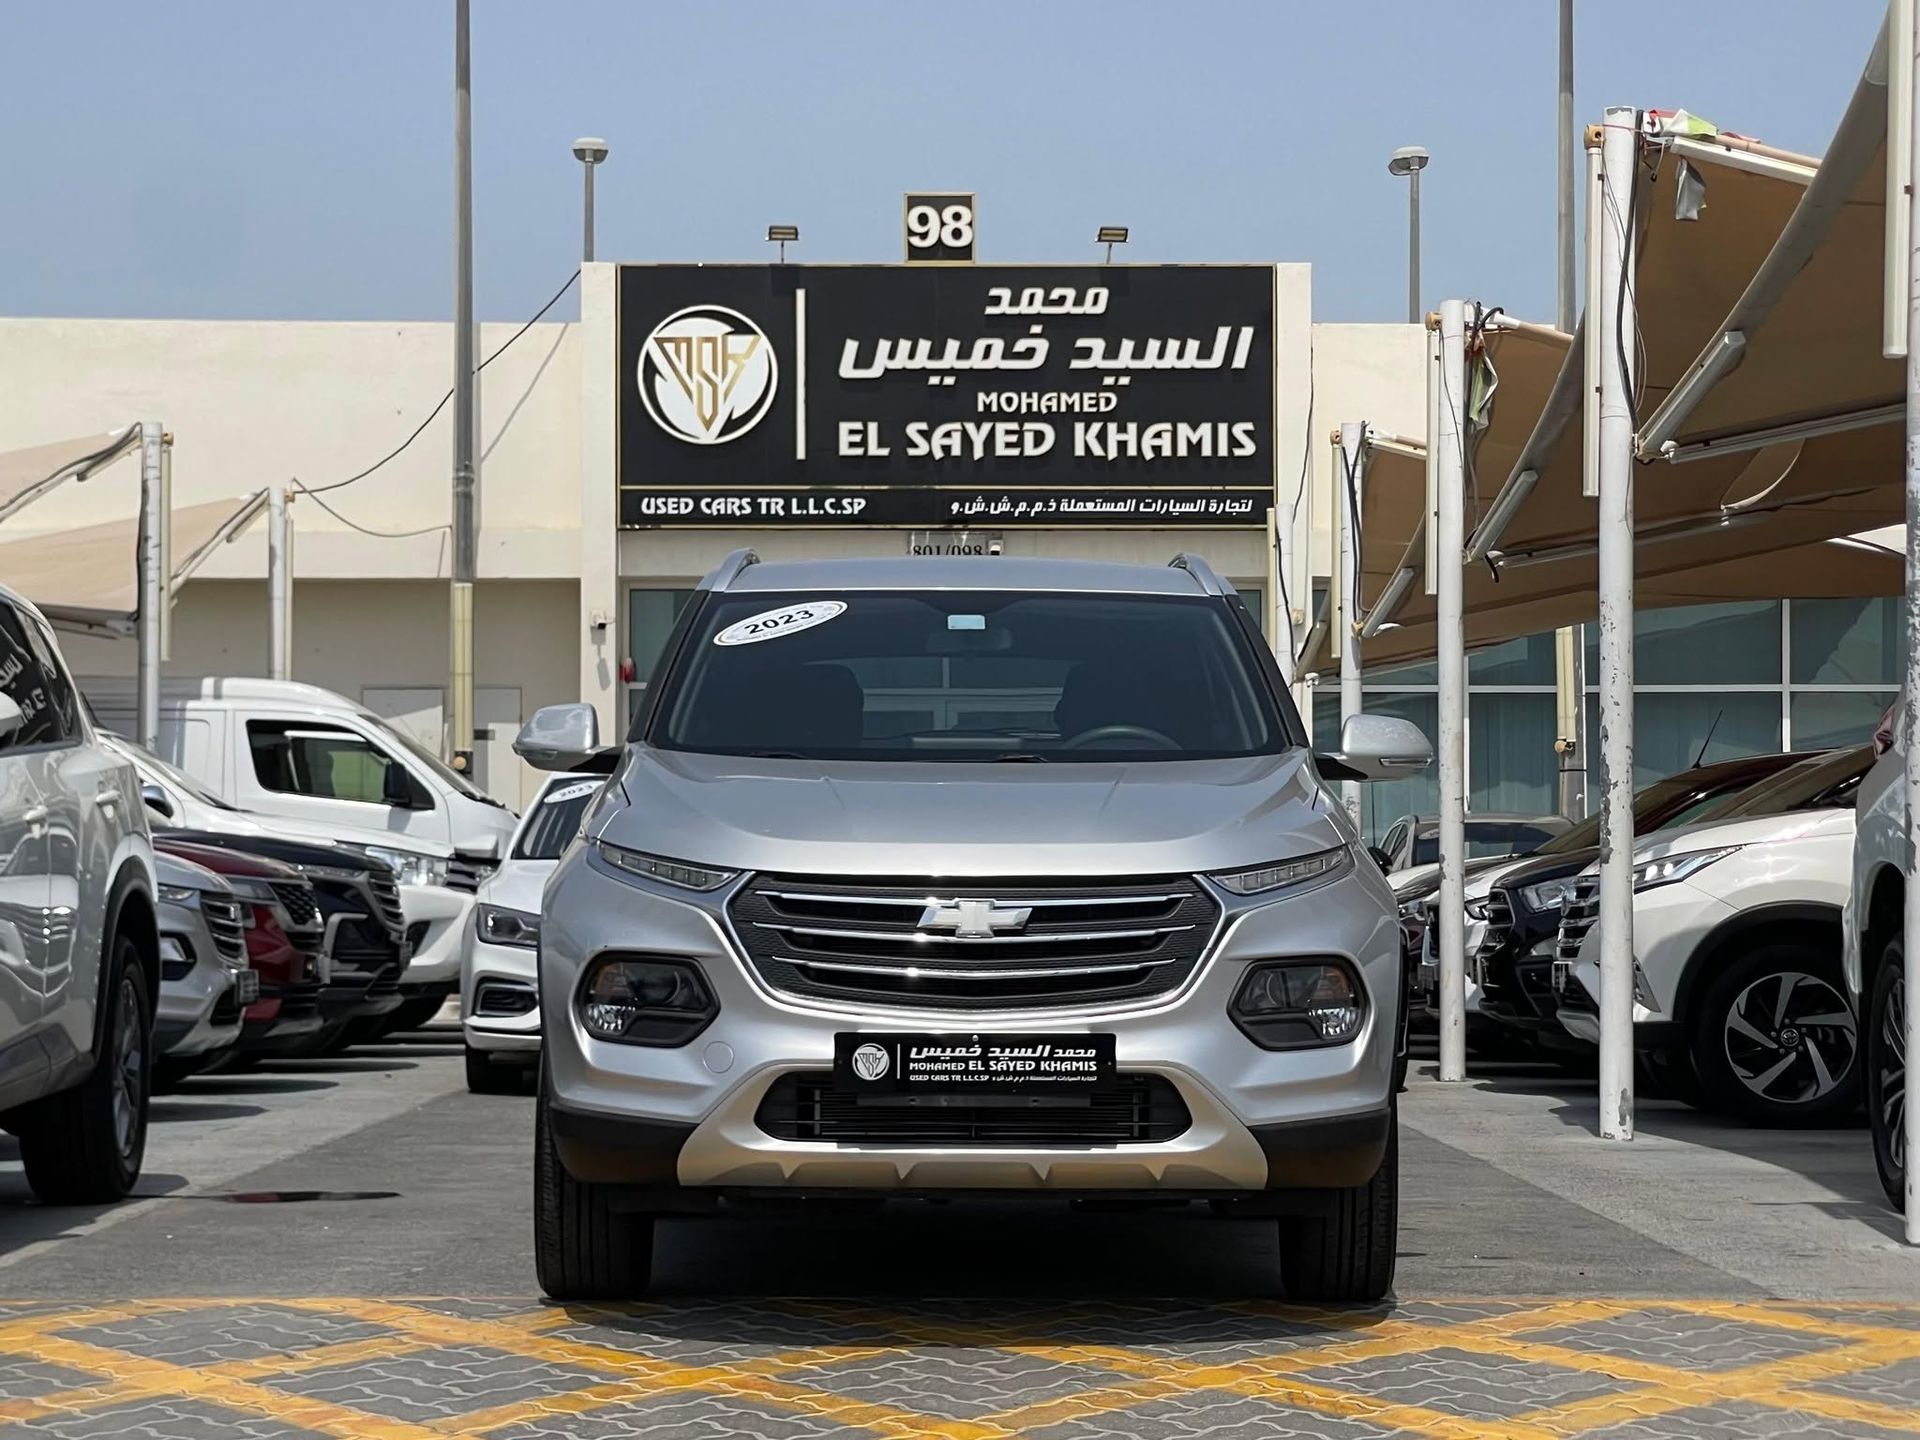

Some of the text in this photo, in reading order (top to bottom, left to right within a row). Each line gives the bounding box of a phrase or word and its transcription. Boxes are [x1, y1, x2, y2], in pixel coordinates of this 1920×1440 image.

[908, 205, 973, 248] 98
[984, 287, 1109, 315] محمد
[838, 324, 1254, 386] السيد خميس
[977, 391, 1118, 414] MOHAMED
[838, 421, 1256, 461] EL SAYED KHAMIS
[641, 497, 867, 516] USED CARS TR L.L.C.SP
[1059, 498, 1136, 513] المستعملة
[1138, 498, 1206, 517] السيارات
[1208, 498, 1253, 516] لتجارة
[744, 609, 815, 635] 2023
[559, 785, 593, 797] 2023
[909, 1044, 1097, 1060] محمد السيد خميس
[909, 1060, 1098, 1072] MOHAMED EL SAYED KHAMIS
[931, 1074, 950, 1082] CARS
[951, 1074, 962, 1082] TR
